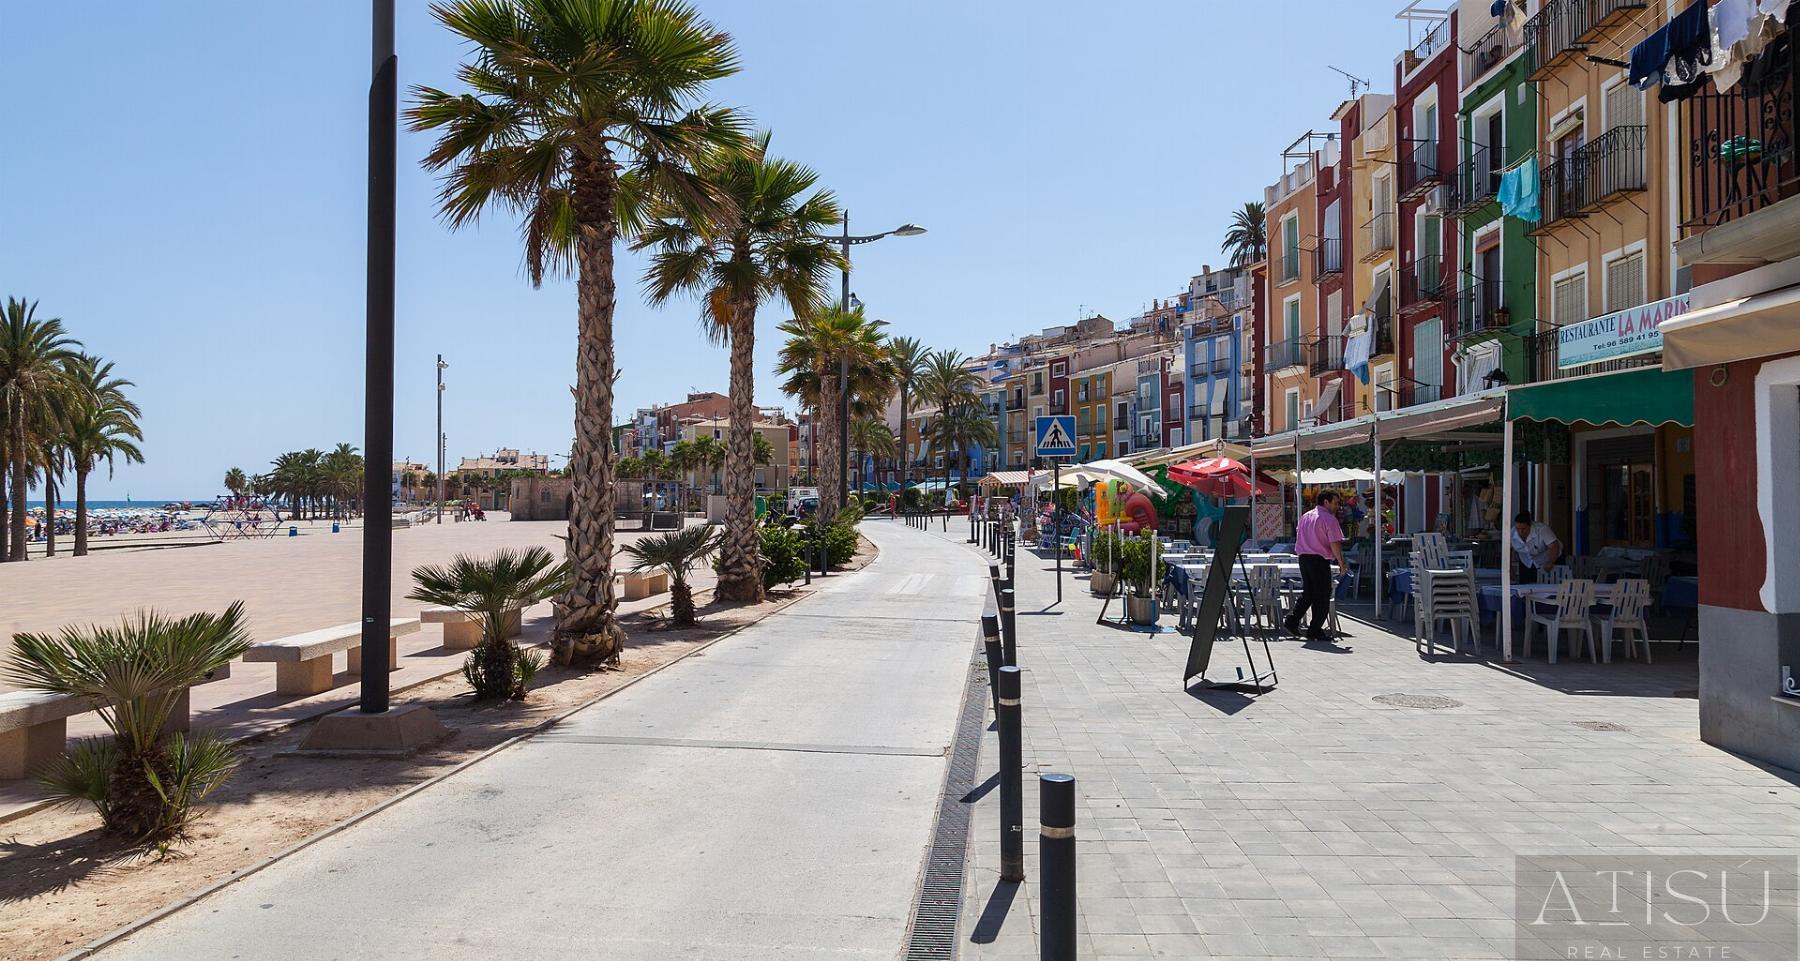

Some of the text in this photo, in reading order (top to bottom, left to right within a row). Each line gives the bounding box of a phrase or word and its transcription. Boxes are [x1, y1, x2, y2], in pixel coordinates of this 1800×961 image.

[1560, 317, 1616, 344] RESTAURANTE
[1618, 311, 1635, 337] LA
[1619, 337, 1634, 345] 589
[1648, 330, 1660, 338] 95
